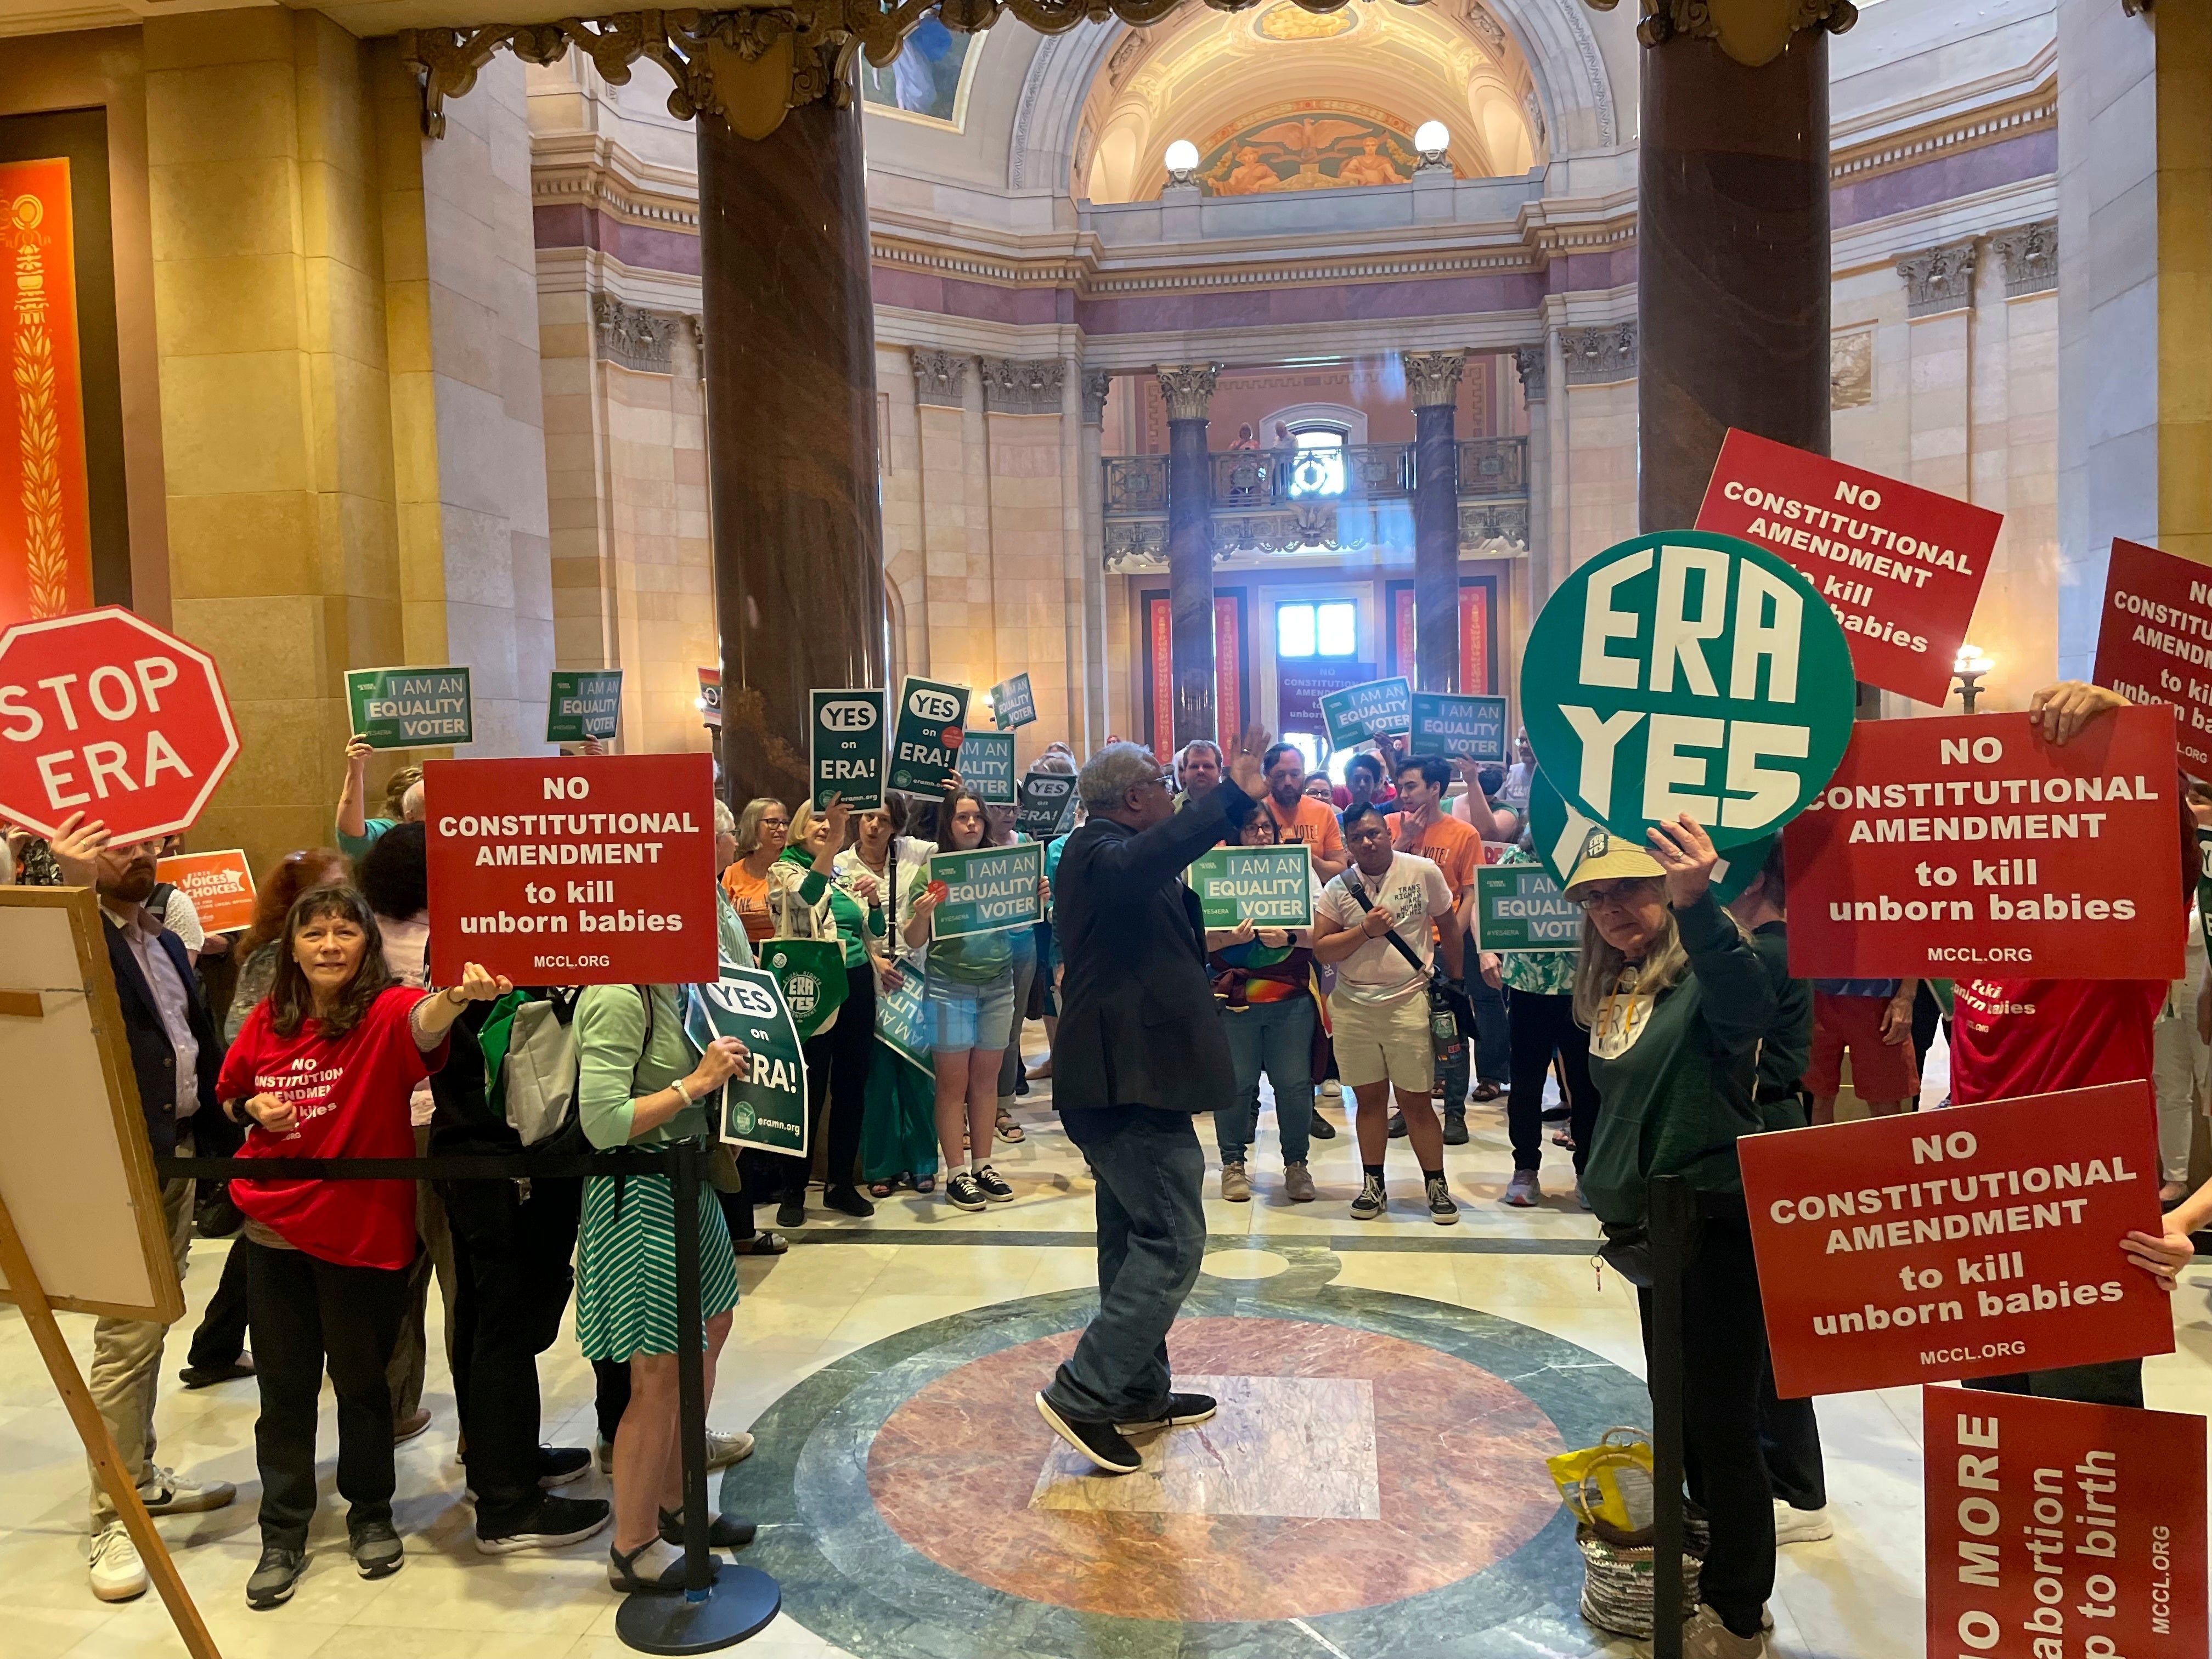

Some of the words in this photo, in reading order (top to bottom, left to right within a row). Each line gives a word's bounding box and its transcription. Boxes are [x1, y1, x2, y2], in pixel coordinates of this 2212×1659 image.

[1834, 481, 1881, 510] NO
[1724, 481, 1972, 575] CONSTITUTIONAL
[1747, 517, 1932, 588] AMENDMENT
[1824, 575, 1873, 607] kill
[1579, 545, 1803, 703] ERA
[1831, 605, 1928, 653] babies
[392, 680, 396, 695] I
[403, 679, 432, 695] AM
[439, 678, 462, 693] AN
[580, 682, 583, 695] I
[588, 681, 603, 695] AM
[606, 680, 619, 693] AN
[1005, 684, 1016, 697] AM
[1018, 680, 1028, 691] AN
[2161, 669, 2181, 692] to
[0, 657, 178, 742] STOP
[563, 698, 617, 714] EQUALITY
[999, 692, 1029, 714] EQUALITY
[1351, 696, 1356, 706] I
[1360, 690, 1381, 704] AM
[1386, 686, 1404, 698] AN
[369, 698, 464, 718] EQUALITY
[916, 695, 953, 718] YES
[1009, 706, 1032, 722] VOTER
[1339, 699, 1407, 725] EQUALITY
[1441, 704, 1444, 716] I
[1449, 705, 1472, 718] AM
[1477, 707, 1499, 719] AN
[404, 718, 465, 736] VOTER
[585, 716, 614, 732] VOTER
[826, 708, 870, 726] YES
[1365, 714, 1409, 731] VOTER
[922, 728, 936, 737] on
[1424, 720, 1499, 736] EQUALITY
[899, 742, 951, 768] ERA!
[985, 743, 1007, 756] AN
[1447, 738, 1498, 753] VOTER
[1940, 737, 2002, 765] NO
[2177, 742, 2208, 763] L.ORG
[36, 730, 194, 810] ERA
[821, 759, 875, 779] ERA!
[960, 760, 1008, 775] ALITY
[1558, 704, 1810, 830] YES
[544, 776, 589, 800] NO
[913, 779, 946, 789] eramn.o
[965, 779, 1008, 793] OTER
[1034, 782, 1064, 793] YES
[439, 812, 699, 837] CONSTITUTIONAL
[1018, 810, 1058, 821] ERA!
[1294, 825, 1318, 839] VOTE!
[1849, 813, 2106, 843] AMENDMENT
[1588, 842, 1605, 856] YES
[1589, 833, 1604, 848] ERA
[476, 843, 663, 866] AMENDMENT
[1424, 845, 1449, 864] VOTE!
[970, 864, 973, 879] I
[980, 860, 1007, 878] AM
[1013, 856, 1035, 873] AN
[1231, 860, 1234, 874] I
[1241, 859, 1269, 874] AM
[1276, 858, 1301, 873] AN
[1915, 862, 1957, 887] to
[1973, 859, 2036, 886] kill
[183, 873, 227, 888] VOICES
[187, 882, 238, 898] CHOICES
[949, 876, 1036, 902] EQUALITY
[1209, 879, 1302, 896] EQUALITY
[1398, 884, 1420, 893] TRANS
[1522, 879, 1525, 894] I
[525, 882, 556, 904] to
[568, 881, 614, 903] kill
[1395, 890, 1421, 900] RIGHTS
[980, 896, 1035, 918] VOTER
[1241, 900, 1303, 916] VOTER
[1397, 909, 1421, 919] RIGHTS
[1401, 904, 1421, 912] HUMAN
[1830, 896, 1973, 921] unborn
[1990, 894, 2136, 920] babies
[461, 911, 568, 933] unborn
[579, 910, 682, 932] babies
[940, 914, 969, 922] #YES4ERA
[534, 955, 610, 967] MCCL.ORG
[1928, 947, 2032, 962] MCCL.ORG
[789, 977, 814, 995] ERA
[712, 984, 771, 1013] YES
[787, 997, 814, 1011] YES
[1596, 1004, 1641, 1036] ERA
[750, 1028, 769, 1041] on
[291, 1059, 317, 1070] NO
[255, 1067, 343, 1088] ONSTITUTION
[758, 1117, 800, 1136] eramn.org
[1912, 1131, 1977, 1164] NO
[1770, 1156, 2137, 1224] CONSTITUTIONAL
[1825, 1198, 2087, 1254] AMENDMENT
[1899, 1265, 1943, 1291] to
[1957, 1251, 2024, 1284] kill
[1813, 1299, 1963, 1336] unborn
[1978, 1281, 2124, 1317] babies
[1920, 1341, 2025, 1365] MCCL.ORG
[1957, 1414, 2000, 1588] MORE
[2075, 1450, 2116, 1558] birth
[2023, 1468, 2063, 1659] abortion
[2152, 1525, 2170, 1634] MCCL.ORG
[2076, 1575, 2116, 1618] to
[1958, 1611, 2000, 1659] O
[2086, 1635, 2125, 1659] p
